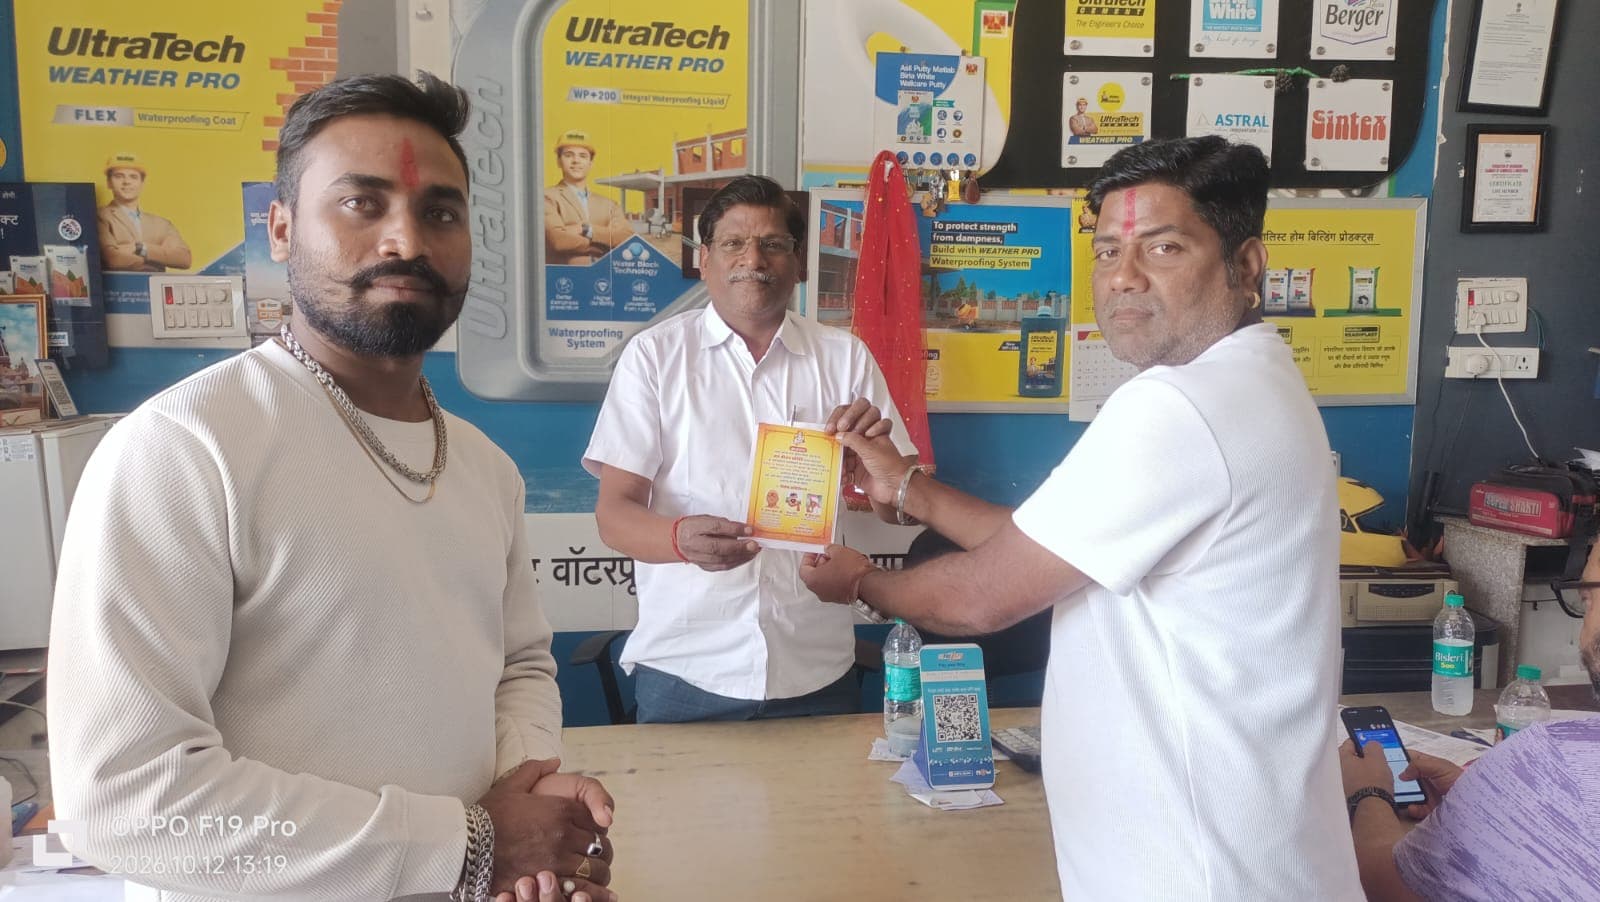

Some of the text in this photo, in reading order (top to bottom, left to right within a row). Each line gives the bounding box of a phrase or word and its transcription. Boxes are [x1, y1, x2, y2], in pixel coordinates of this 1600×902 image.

[1325, 4, 1384, 32] Berger
[565, 16, 730, 50] UltraTech
[47, 26, 246, 63] UltraTech
[565, 51, 725, 73] WEATHER PRO
[914, 65, 930, 73] Putty
[49, 66, 241, 90] WEATHER PRO
[573, 88, 617, 100] WP+200
[651, 94, 702, 105] Waterproofing
[702, 96, 725, 106] Liquid
[74, 109, 236, 126] FLEX Waterproofing Coat
[1215, 114, 1269, 127] ASTRAL
[1312, 110, 1386, 140] Sintex
[933, 221, 1017, 233] To protect strength
[932, 232, 1003, 244] from dampness,
[1290, 229, 1305, 242] होम
[932, 245, 1040, 256] Build with WEATHER PRO
[932, 257, 1030, 268] Waterproofing System
[614, 267, 658, 276] Technology
[548, 327, 624, 339] Waterproofing
[567, 339, 606, 350] System
[551, 546, 638, 595] वॉटरप्रू
